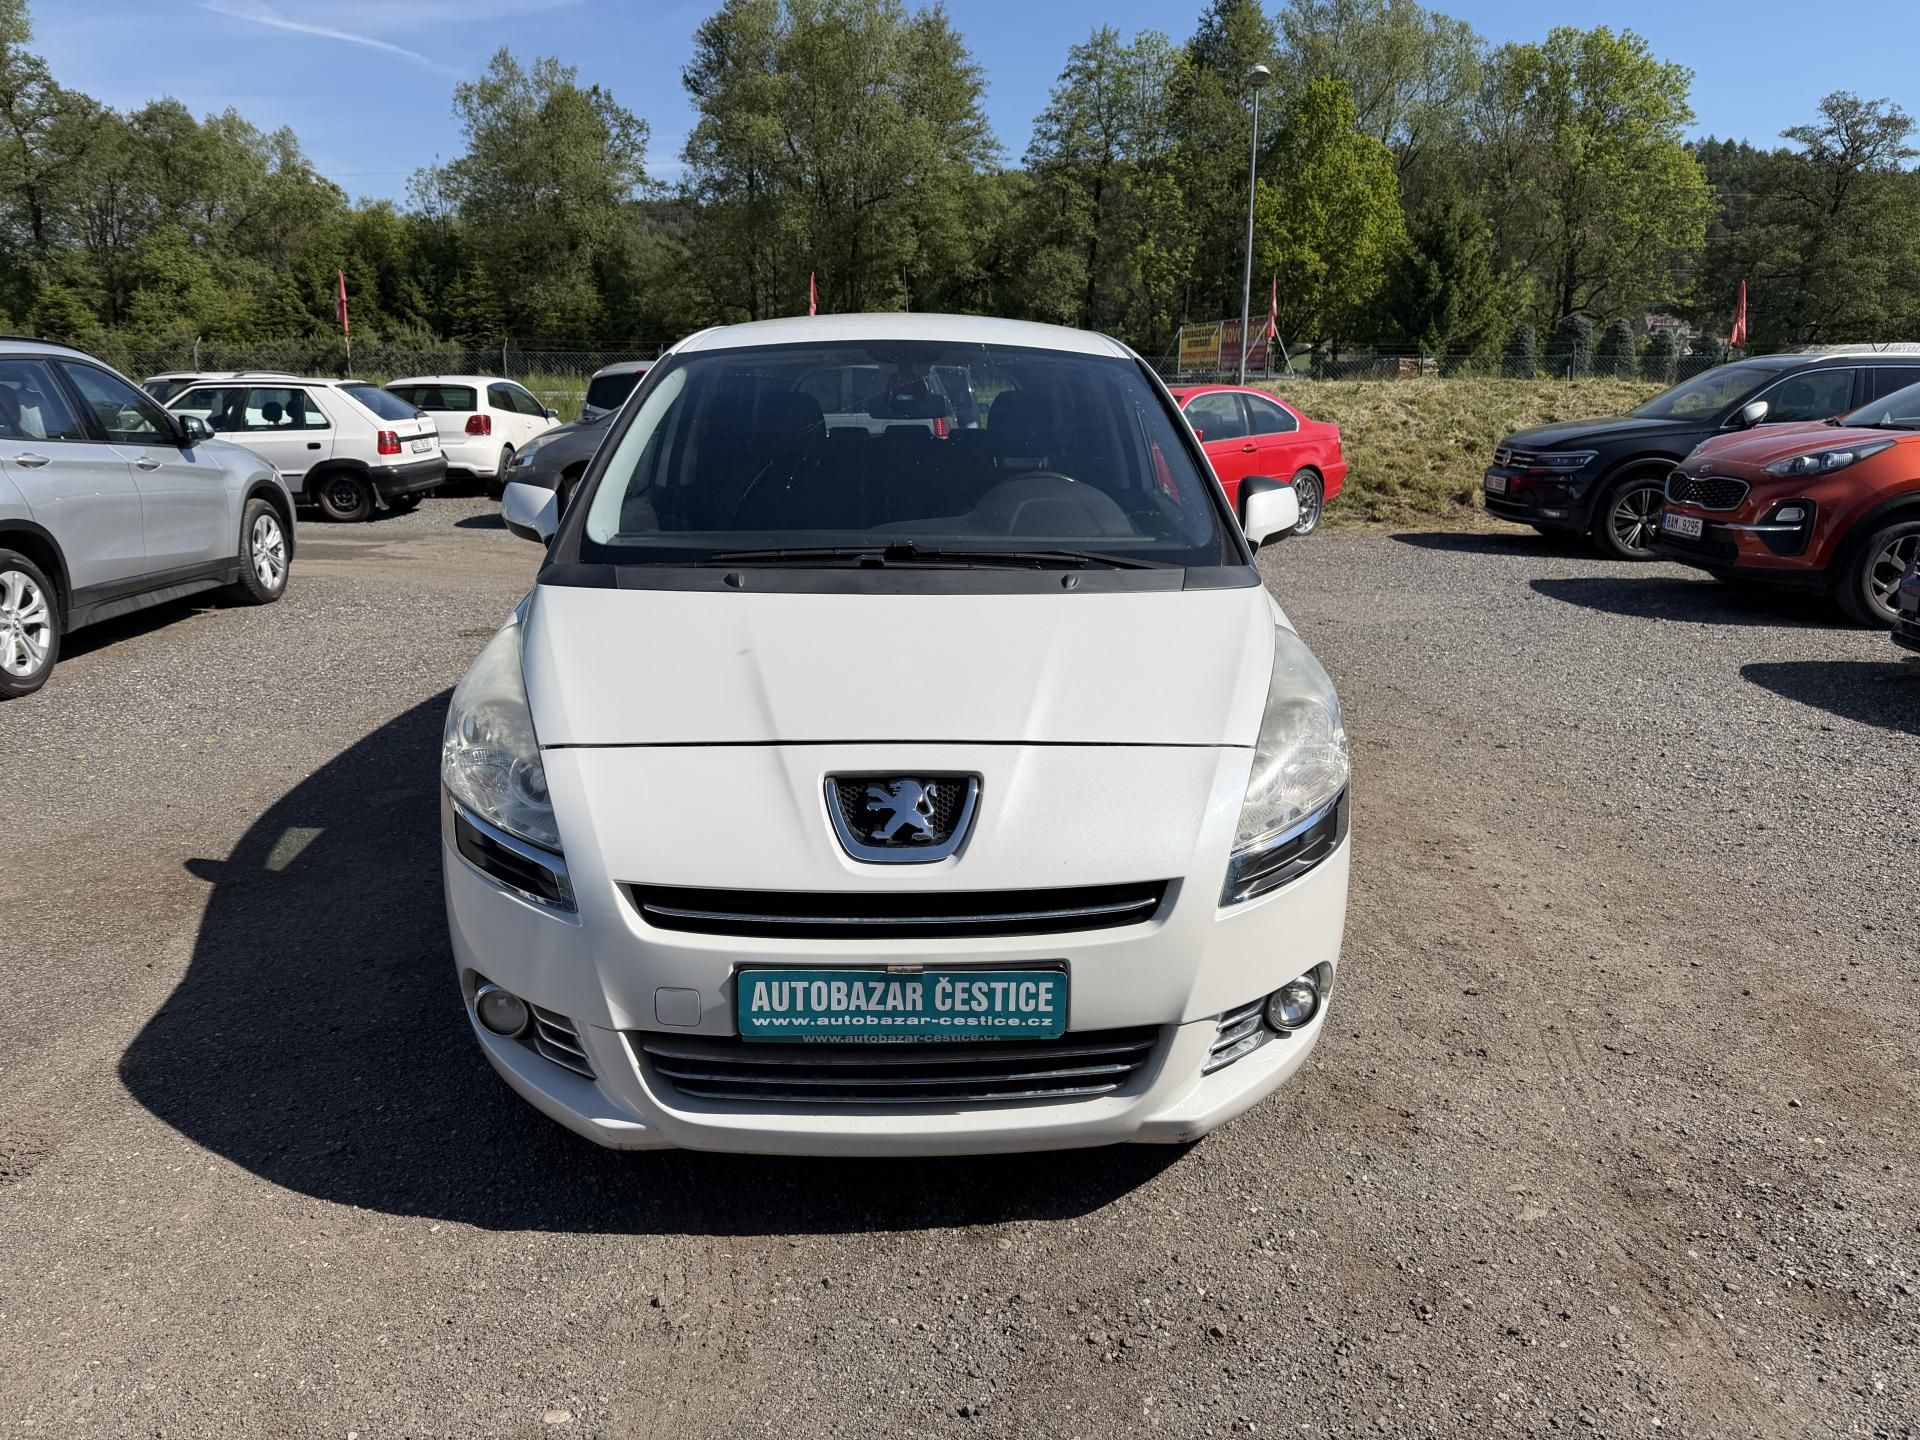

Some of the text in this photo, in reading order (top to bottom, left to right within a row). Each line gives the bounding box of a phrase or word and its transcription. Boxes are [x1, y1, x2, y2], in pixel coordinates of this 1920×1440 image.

[1682, 518, 1700, 533] 9295
[751, 977, 1053, 1012] AUTOBAZAR ČESTICE
[752, 1015, 1053, 1026] www.autobazar-cestice.cz
